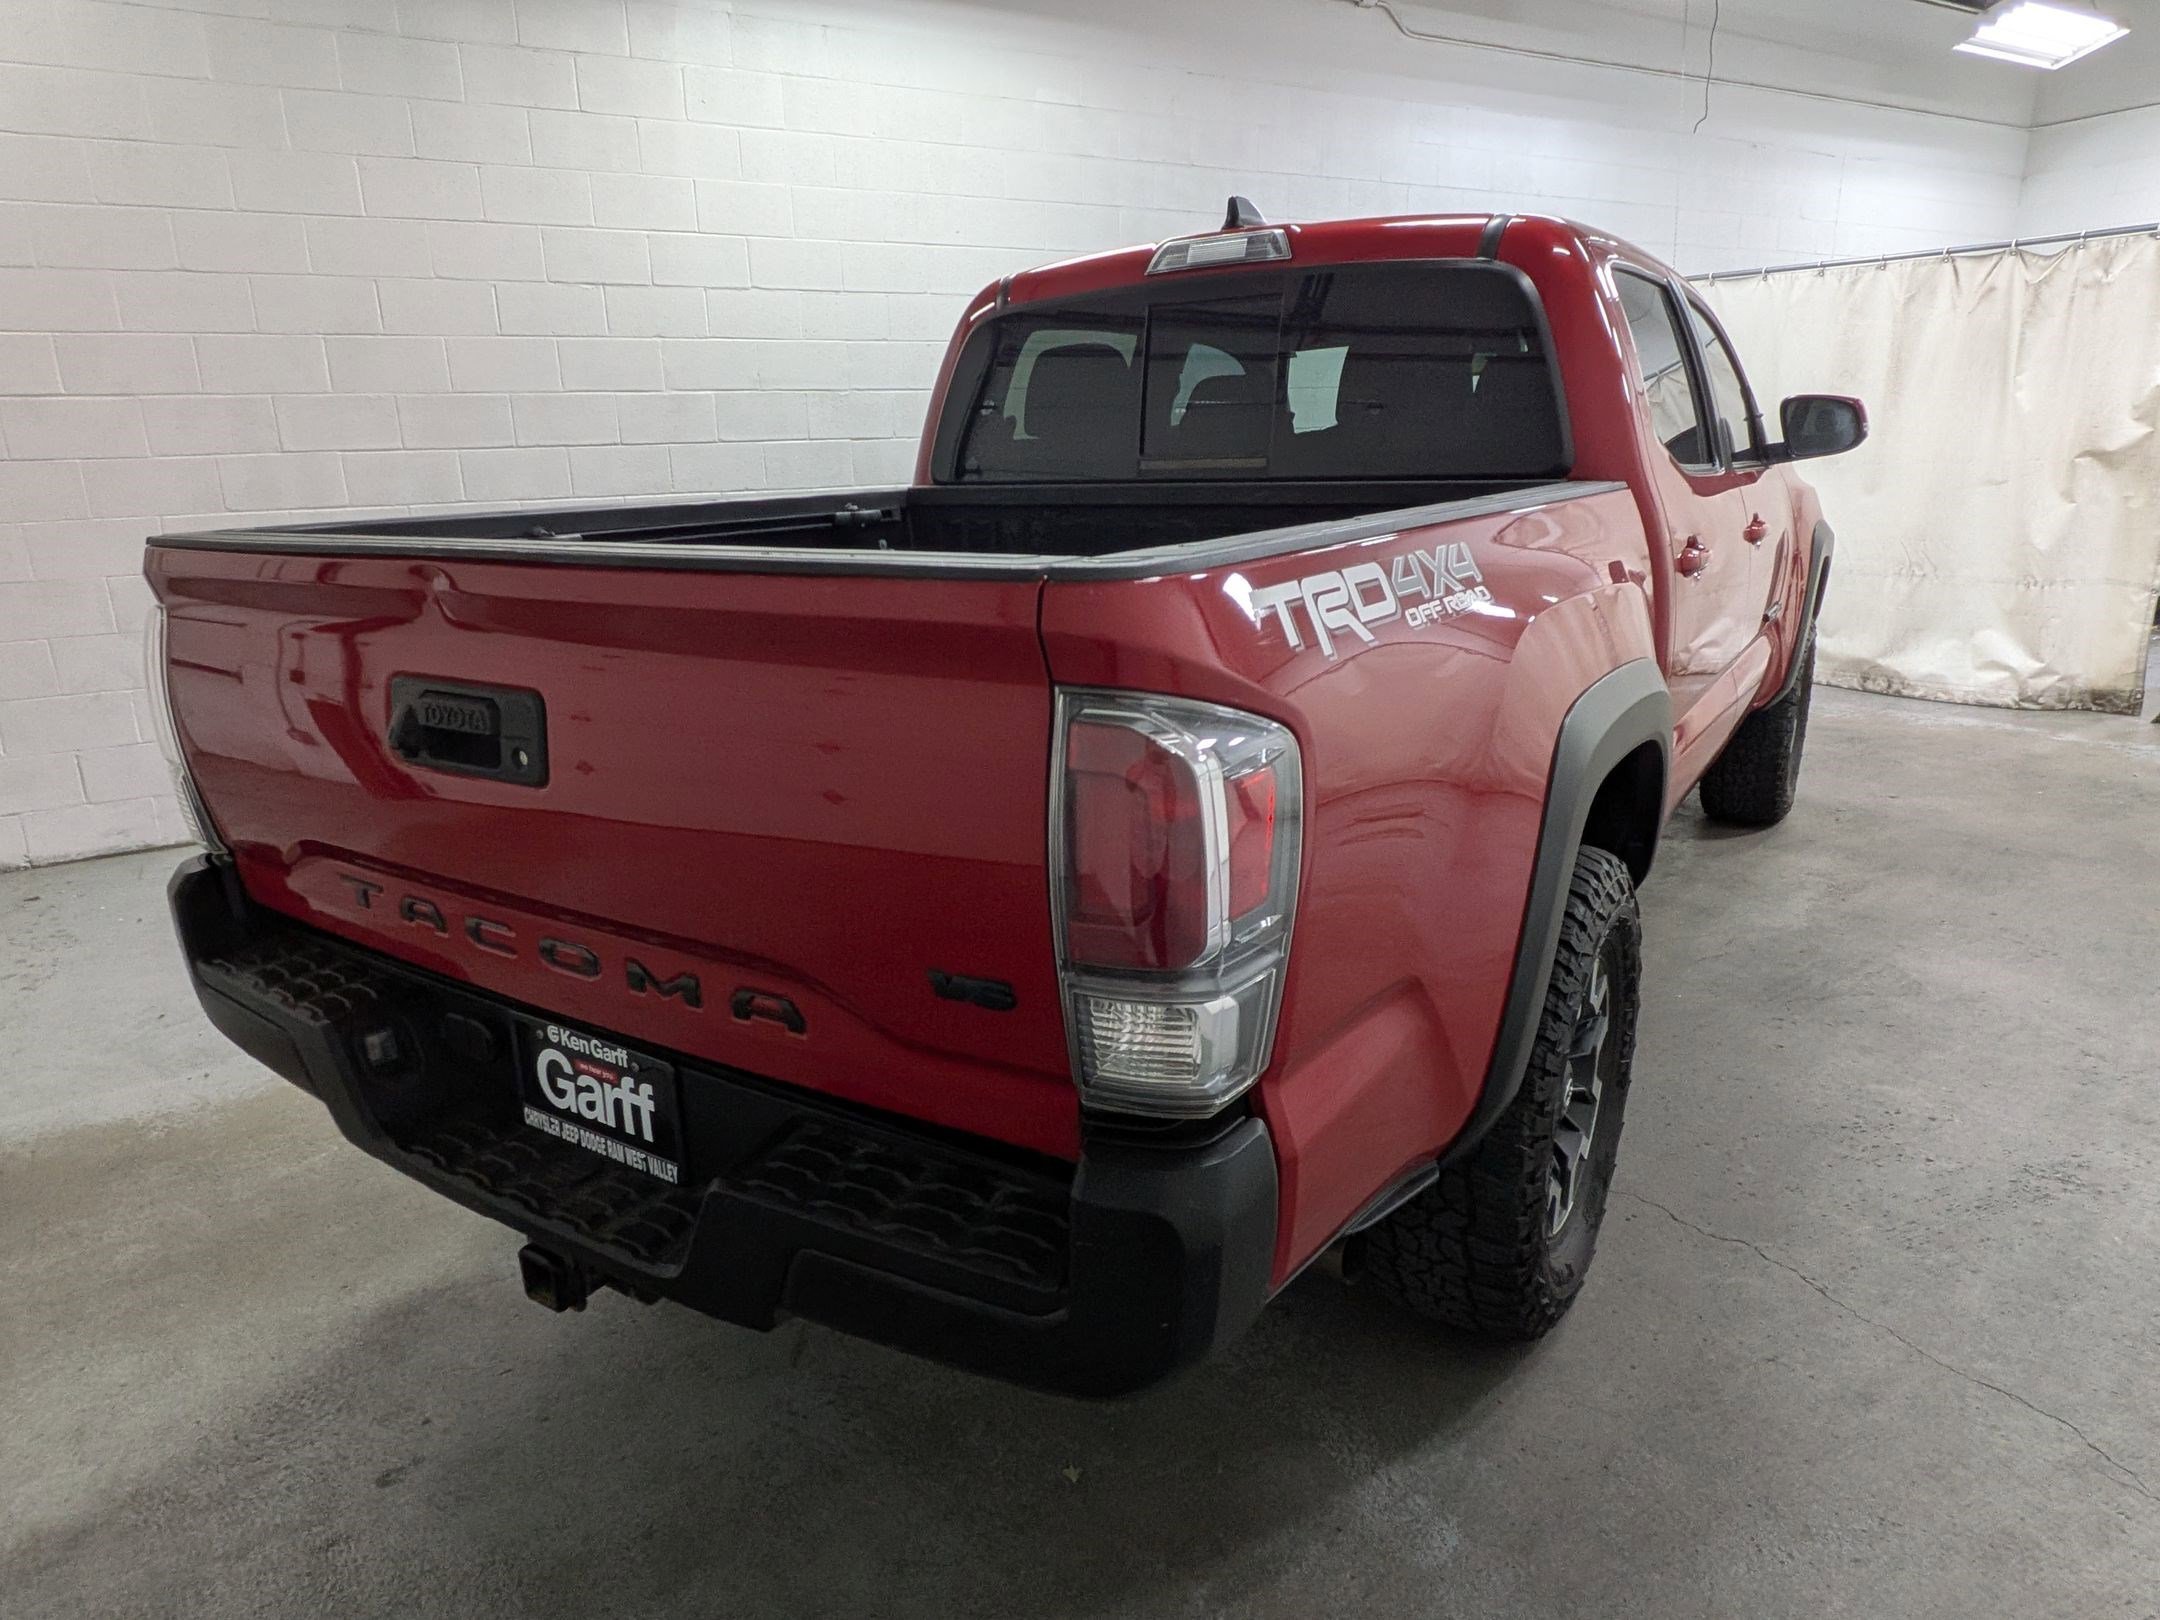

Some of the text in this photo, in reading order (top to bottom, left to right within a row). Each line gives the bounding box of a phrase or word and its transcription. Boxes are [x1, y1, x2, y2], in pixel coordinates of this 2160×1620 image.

[1249, 541, 1483, 660] TRD 4X4
[1405, 585, 1492, 628] OFF ROAD
[423, 702, 488, 731] TOYOTA
[339, 873, 808, 1039] TACOMA
[560, 1027, 628, 1068] Ken Garff
[536, 1048, 655, 1143] Garff
[523, 1106, 678, 1185] CHRYSLER JEEP DODGE RAM WEST VALLEY
